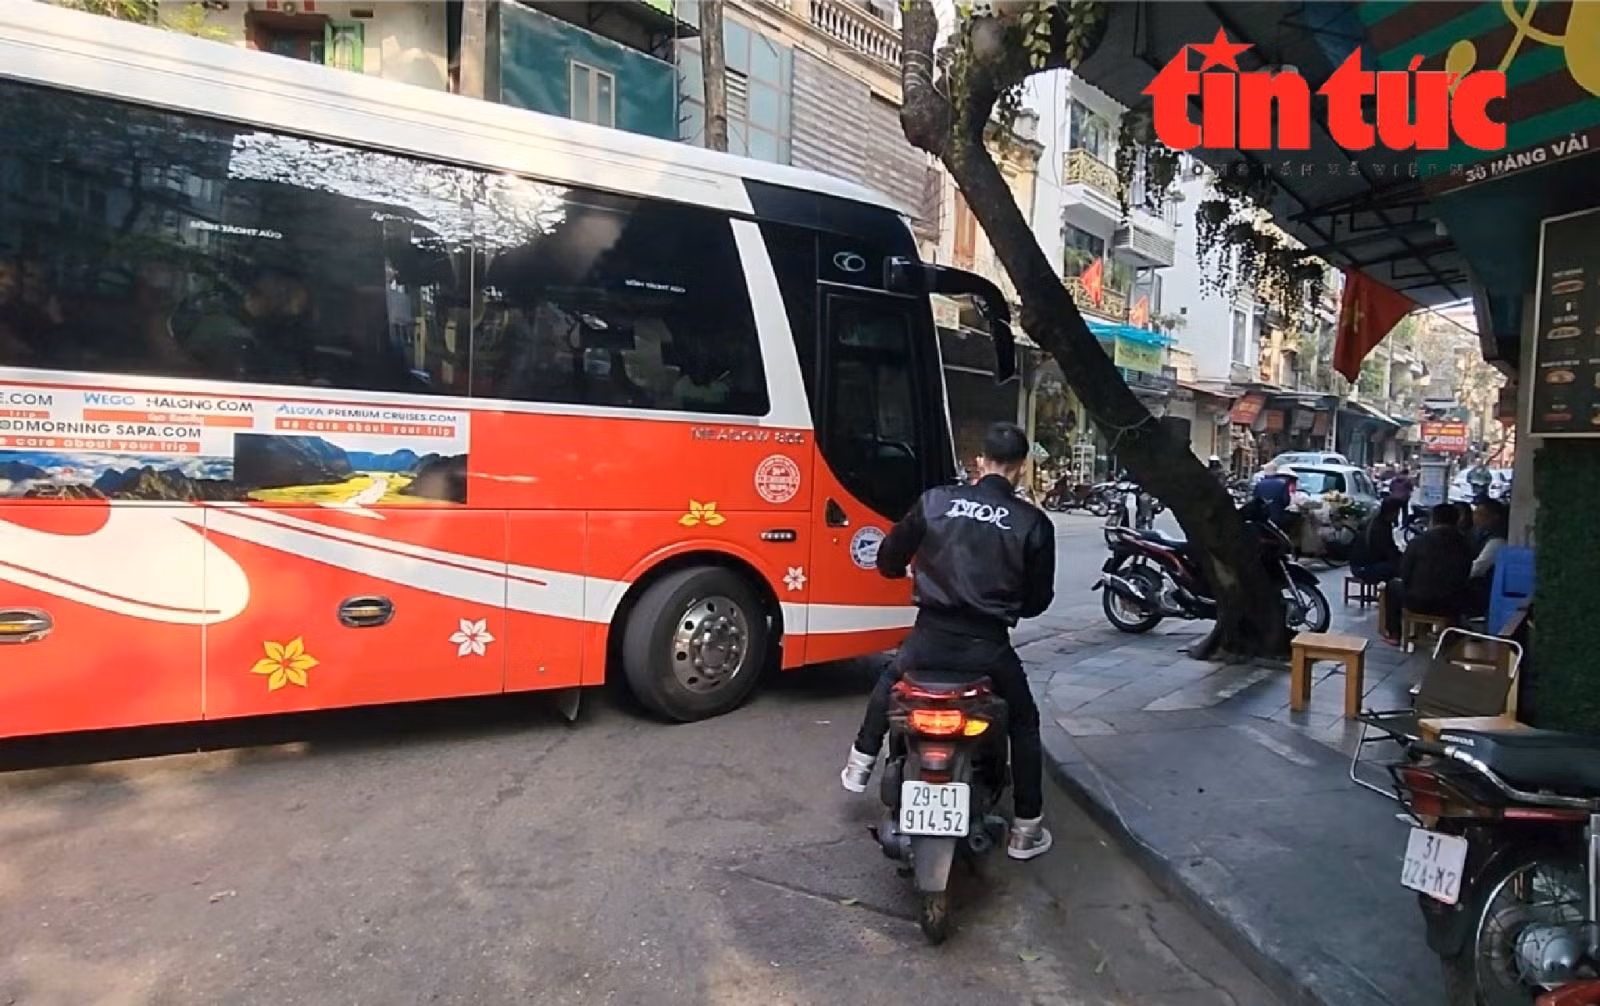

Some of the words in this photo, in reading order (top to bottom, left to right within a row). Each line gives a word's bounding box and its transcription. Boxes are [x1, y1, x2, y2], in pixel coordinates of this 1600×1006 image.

[1551, 132, 1589, 157] VẢI
[83, 391, 136, 407] WEGO
[146, 396, 255, 413] HALONG.COM
[277, 403, 324, 416] ALOVA
[328, 408, 380, 419] PREMIUM
[383, 411, 457, 423] CRUISES.COM
[116, 424, 202, 439] SAPA.COM
[308, 421, 339, 431] care
[347, 421, 385, 433] about
[15, 437, 57, 448] care
[63, 437, 113, 449] about
[118, 440, 154, 452] your
[160, 440, 188, 452] trip
[912, 786, 957, 808] 29-C1
[905, 809, 964, 832] 914.52
[1422, 834, 1442, 863] 31
